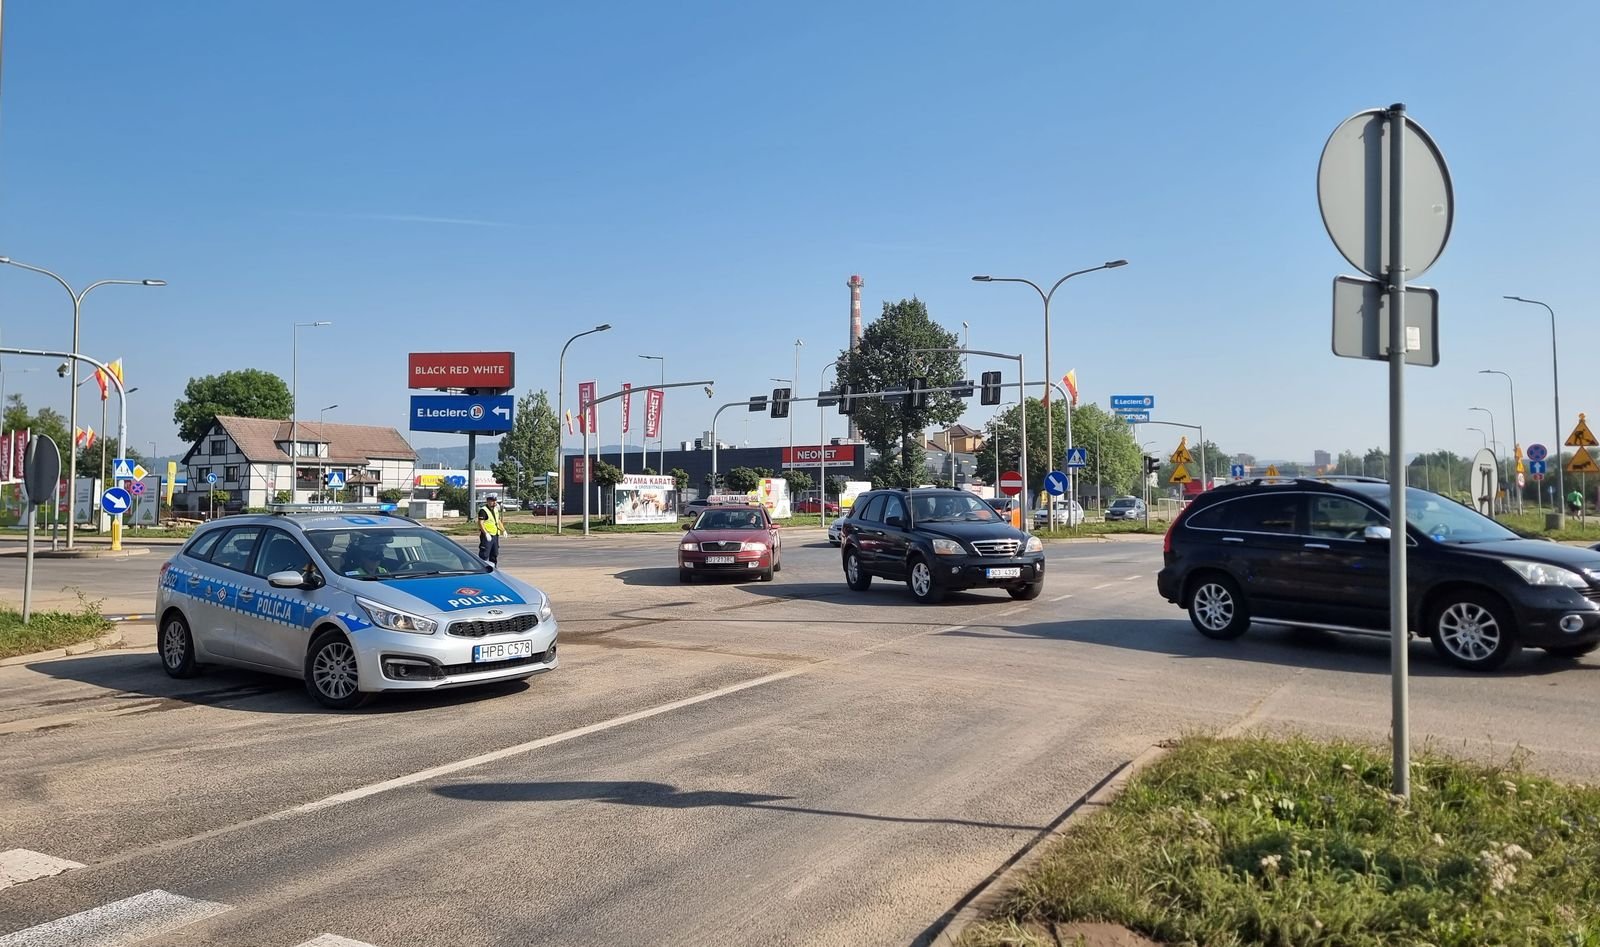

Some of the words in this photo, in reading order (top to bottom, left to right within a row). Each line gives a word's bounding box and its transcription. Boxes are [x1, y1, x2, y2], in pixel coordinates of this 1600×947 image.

[415, 366, 447, 374] BLACK
[450, 366, 469, 374] RED
[473, 365, 505, 374] WHITE
[417, 408, 468, 417] E.Leclerc
[647, 392, 660, 434] NEONET
[797, 450, 837, 460] NEONET
[650, 478, 676, 486] KARATE
[447, 594, 513, 608] POLICJA
[256, 597, 292, 620] POLICJA
[481, 645, 504, 659] HPB
[507, 642, 530, 656] C578
